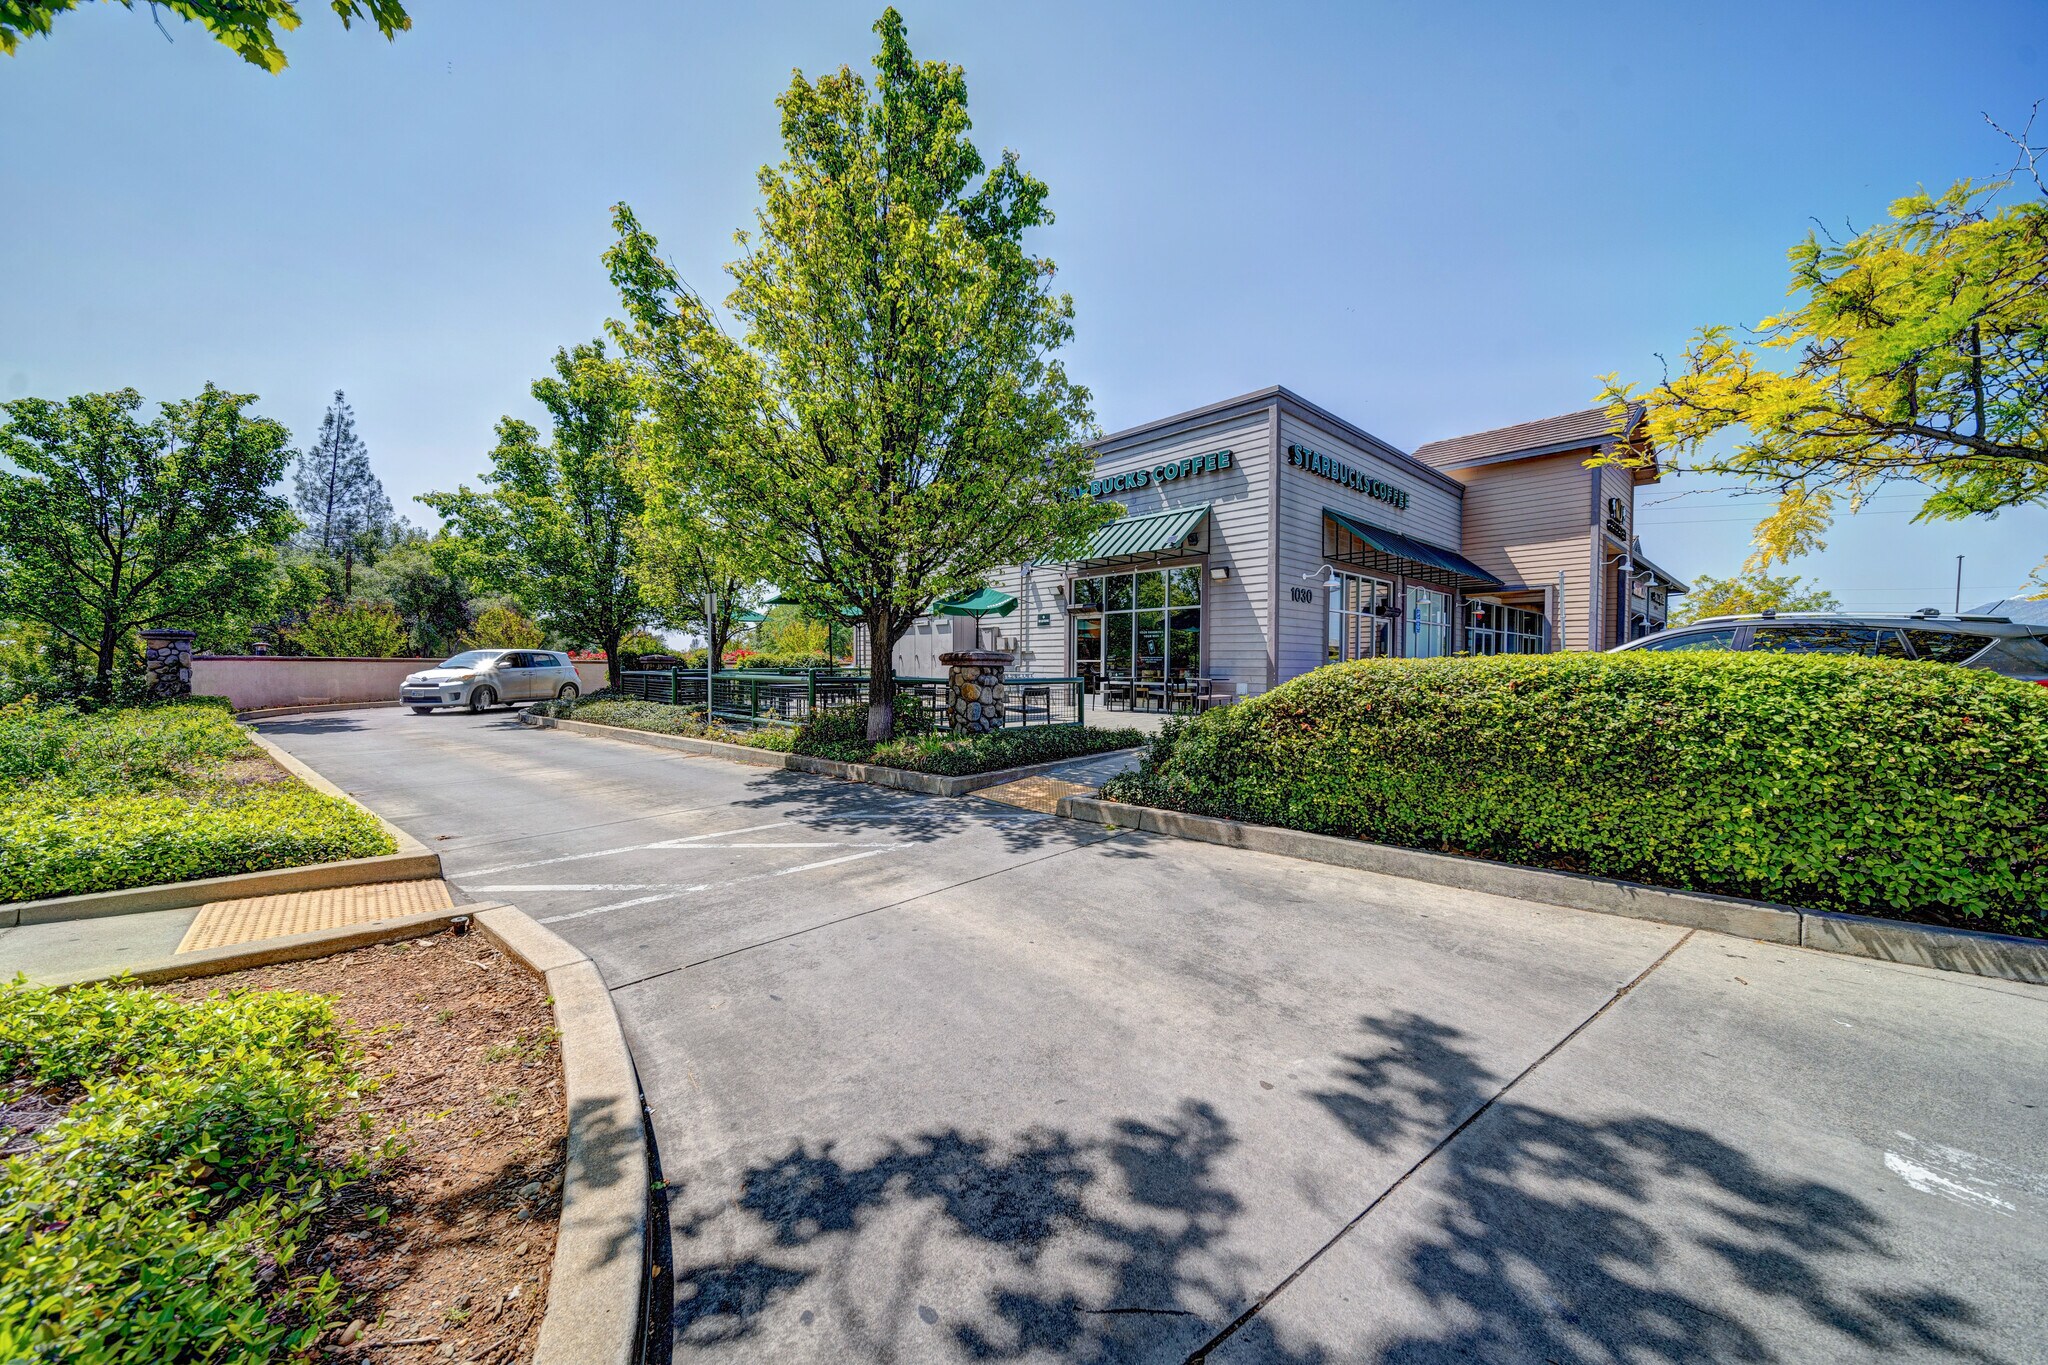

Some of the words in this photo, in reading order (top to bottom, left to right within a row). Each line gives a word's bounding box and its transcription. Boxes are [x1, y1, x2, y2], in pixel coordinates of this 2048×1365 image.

[1066, 470, 1149, 500] BUCKS
[1152, 450, 1233, 483] COFFEE
[1291, 443, 1371, 493] STARBUCKS
[1372, 479, 1410, 509] COFFEE
[1291, 587, 1312, 603] 1030
